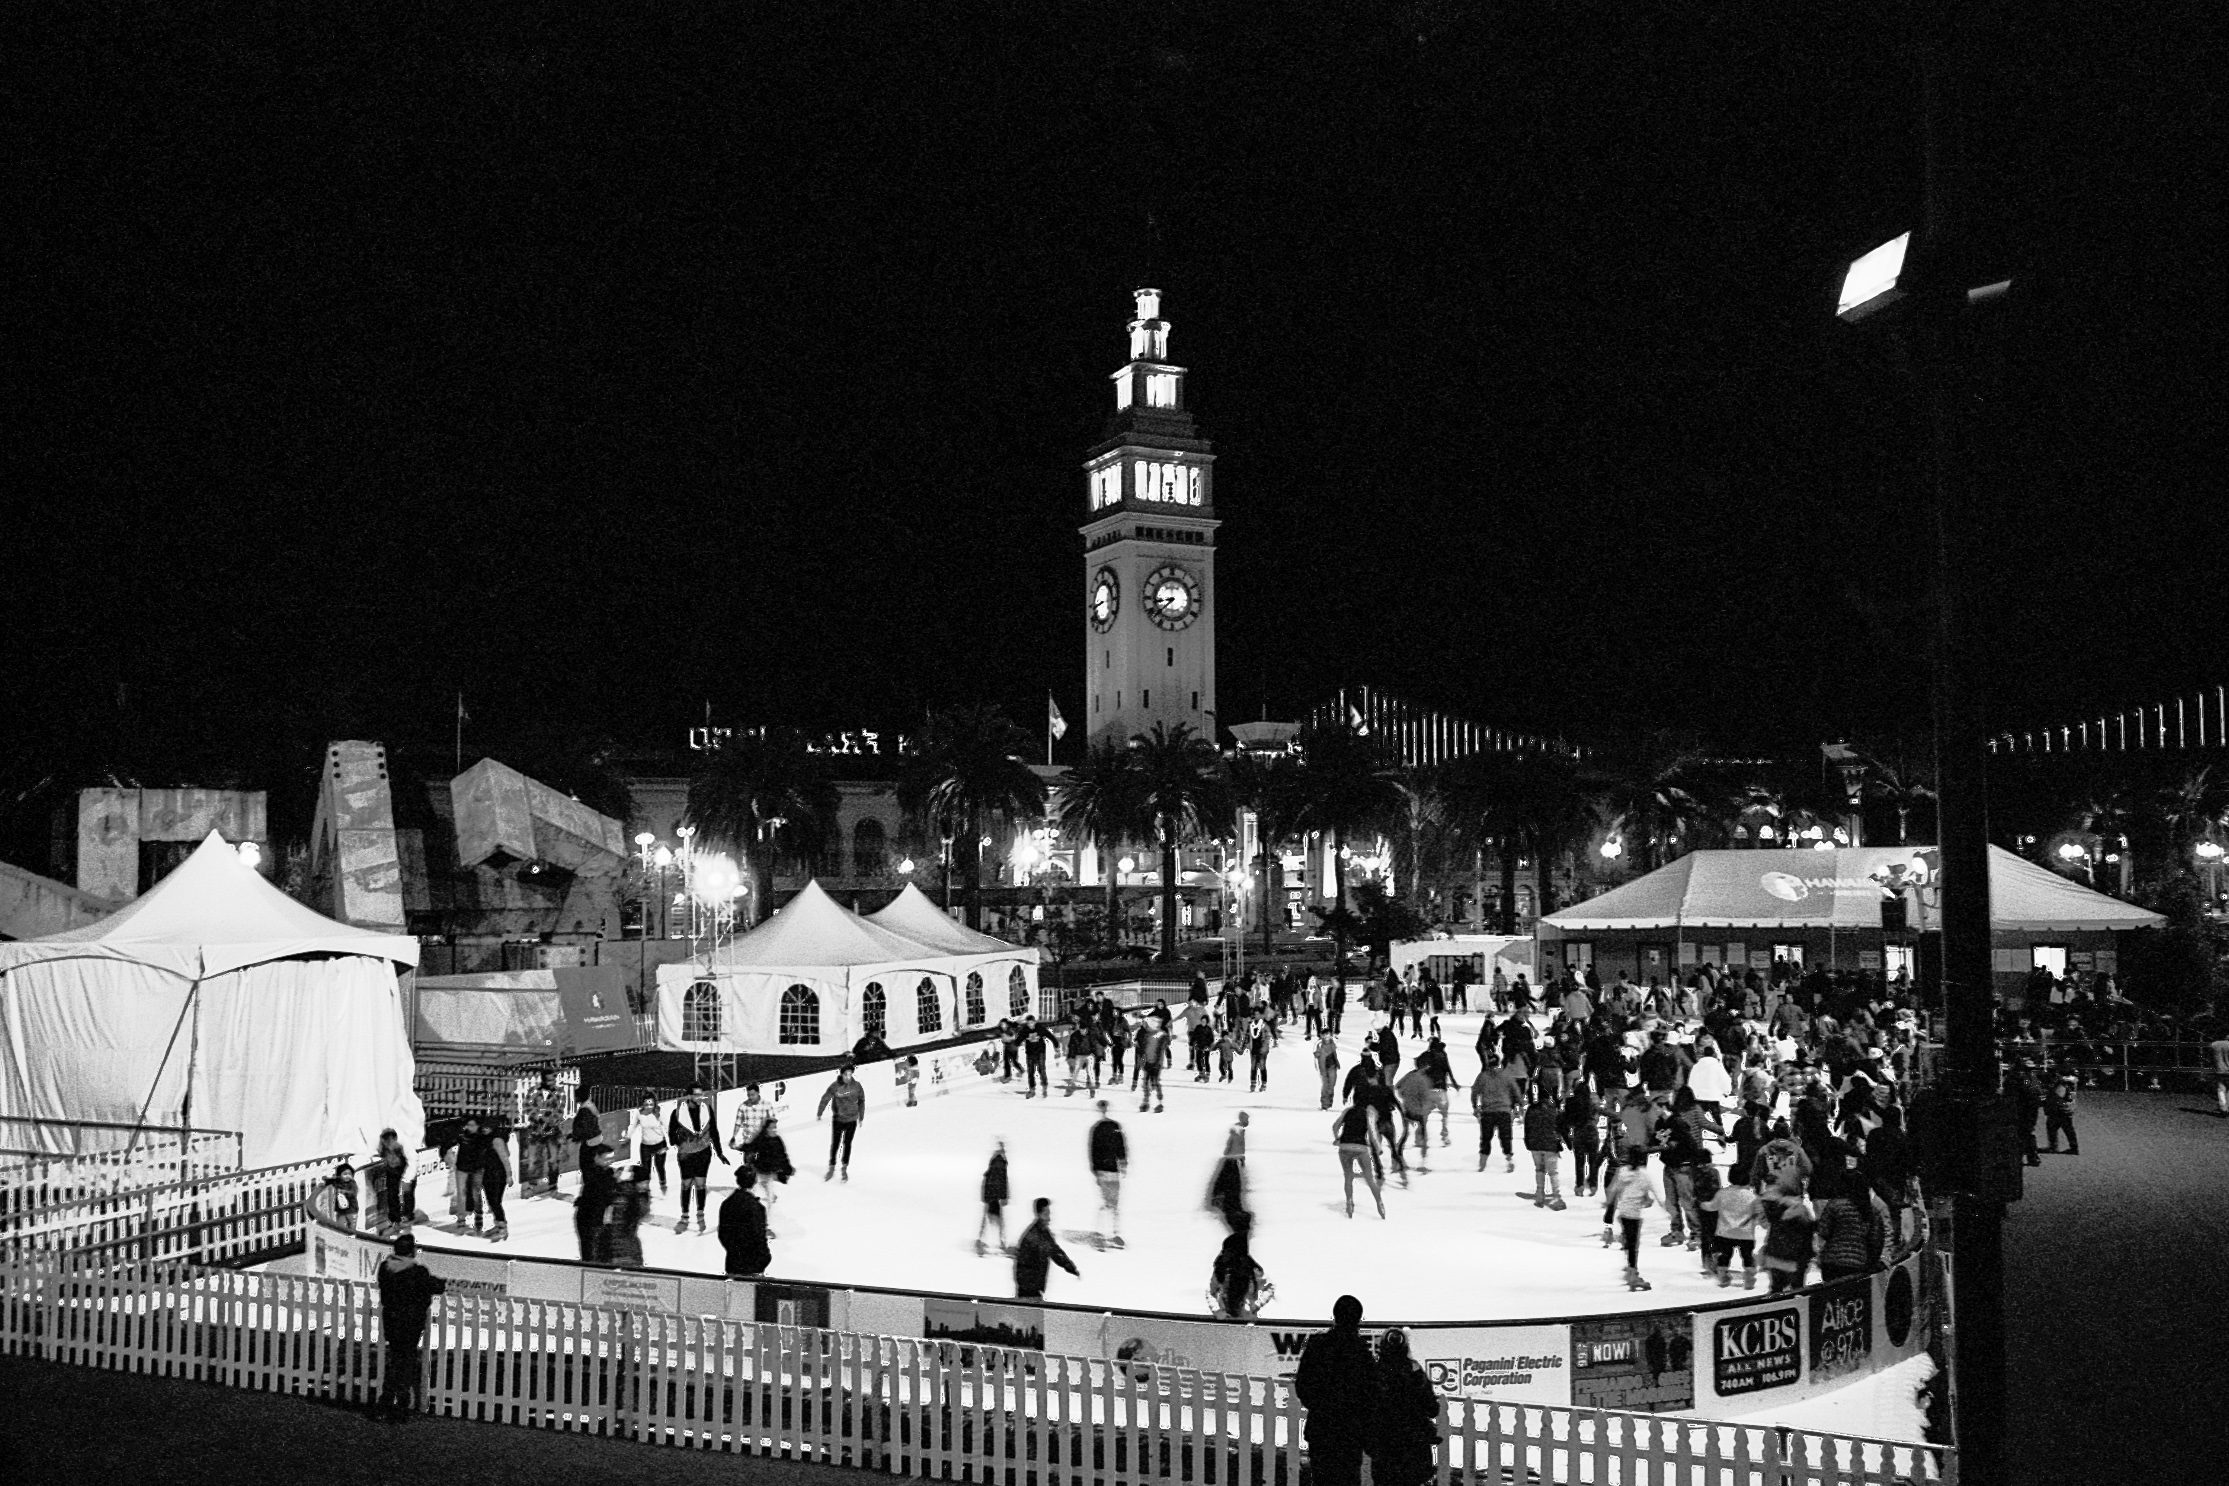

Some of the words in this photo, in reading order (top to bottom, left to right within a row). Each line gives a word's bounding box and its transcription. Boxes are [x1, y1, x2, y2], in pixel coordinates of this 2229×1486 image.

[1821, 1298, 1864, 1335] Alice
[1720, 1315, 1797, 1361] KCBS
[1463, 1356, 1515, 1374] Paganini
[1517, 1355, 1563, 1370] Electric
[1727, 1362, 1752, 1374] ALL
[1757, 1354, 1791, 1369] NEWS
[1463, 1371, 1533, 1389] Corporation
